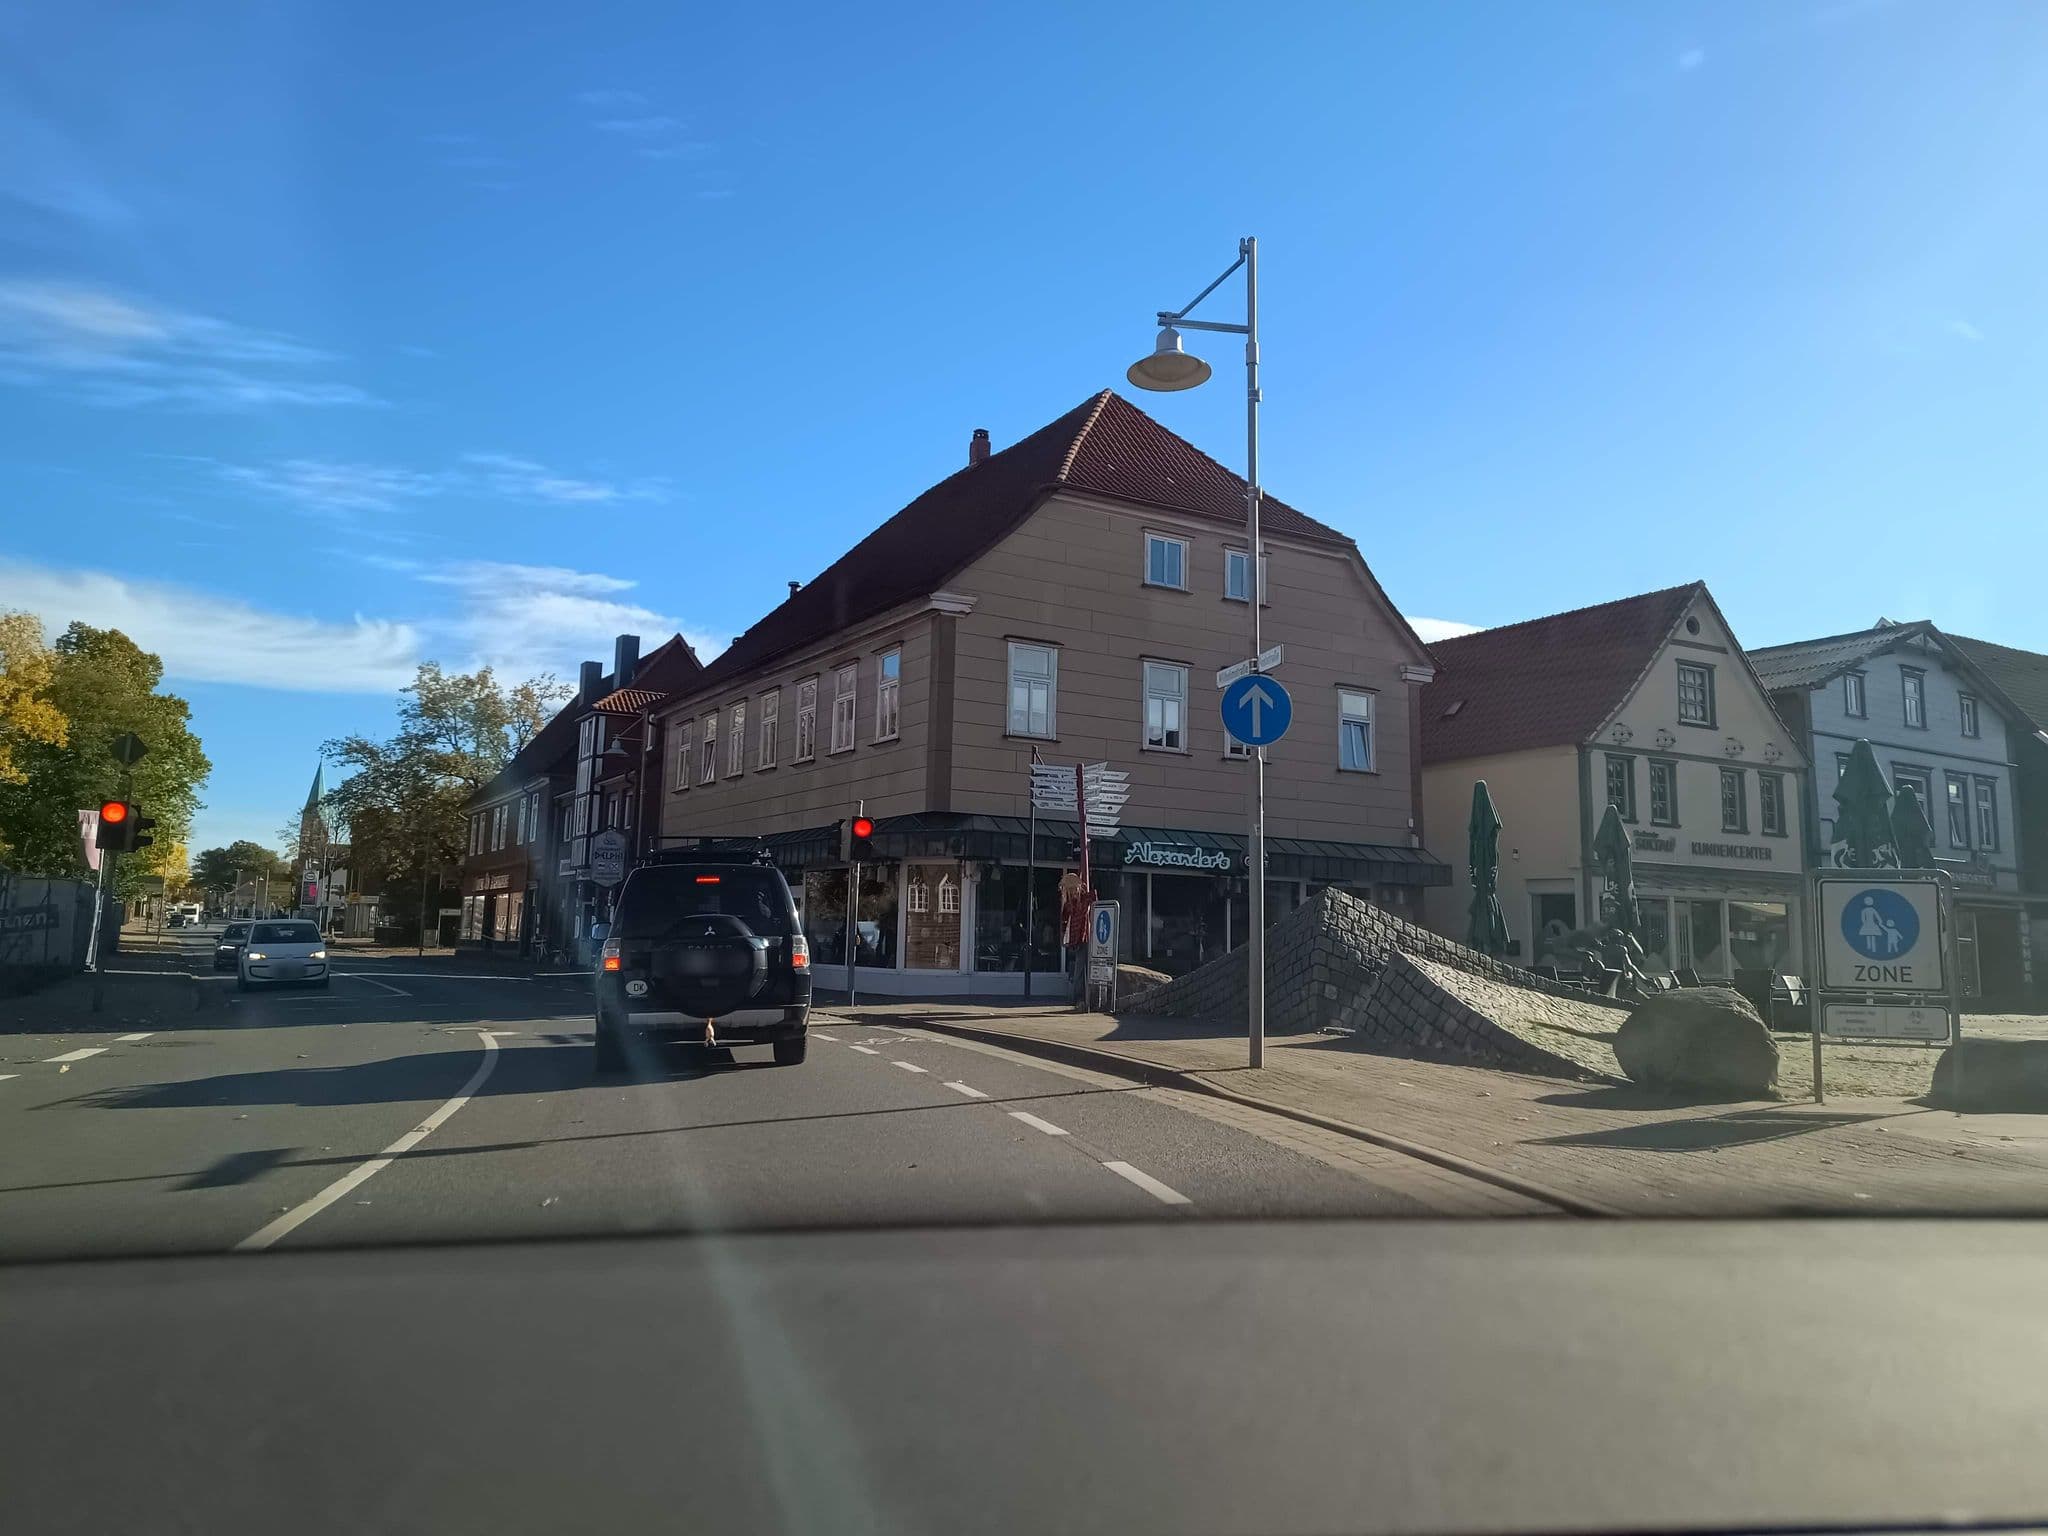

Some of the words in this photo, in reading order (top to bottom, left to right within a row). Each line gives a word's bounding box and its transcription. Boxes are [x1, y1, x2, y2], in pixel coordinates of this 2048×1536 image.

[1125, 842, 1231, 870] Alexander's
[1691, 841, 1773, 861] KUNDENCENTER
[1854, 964, 1913, 983] ZONE
[634, 982, 645, 991] DK
